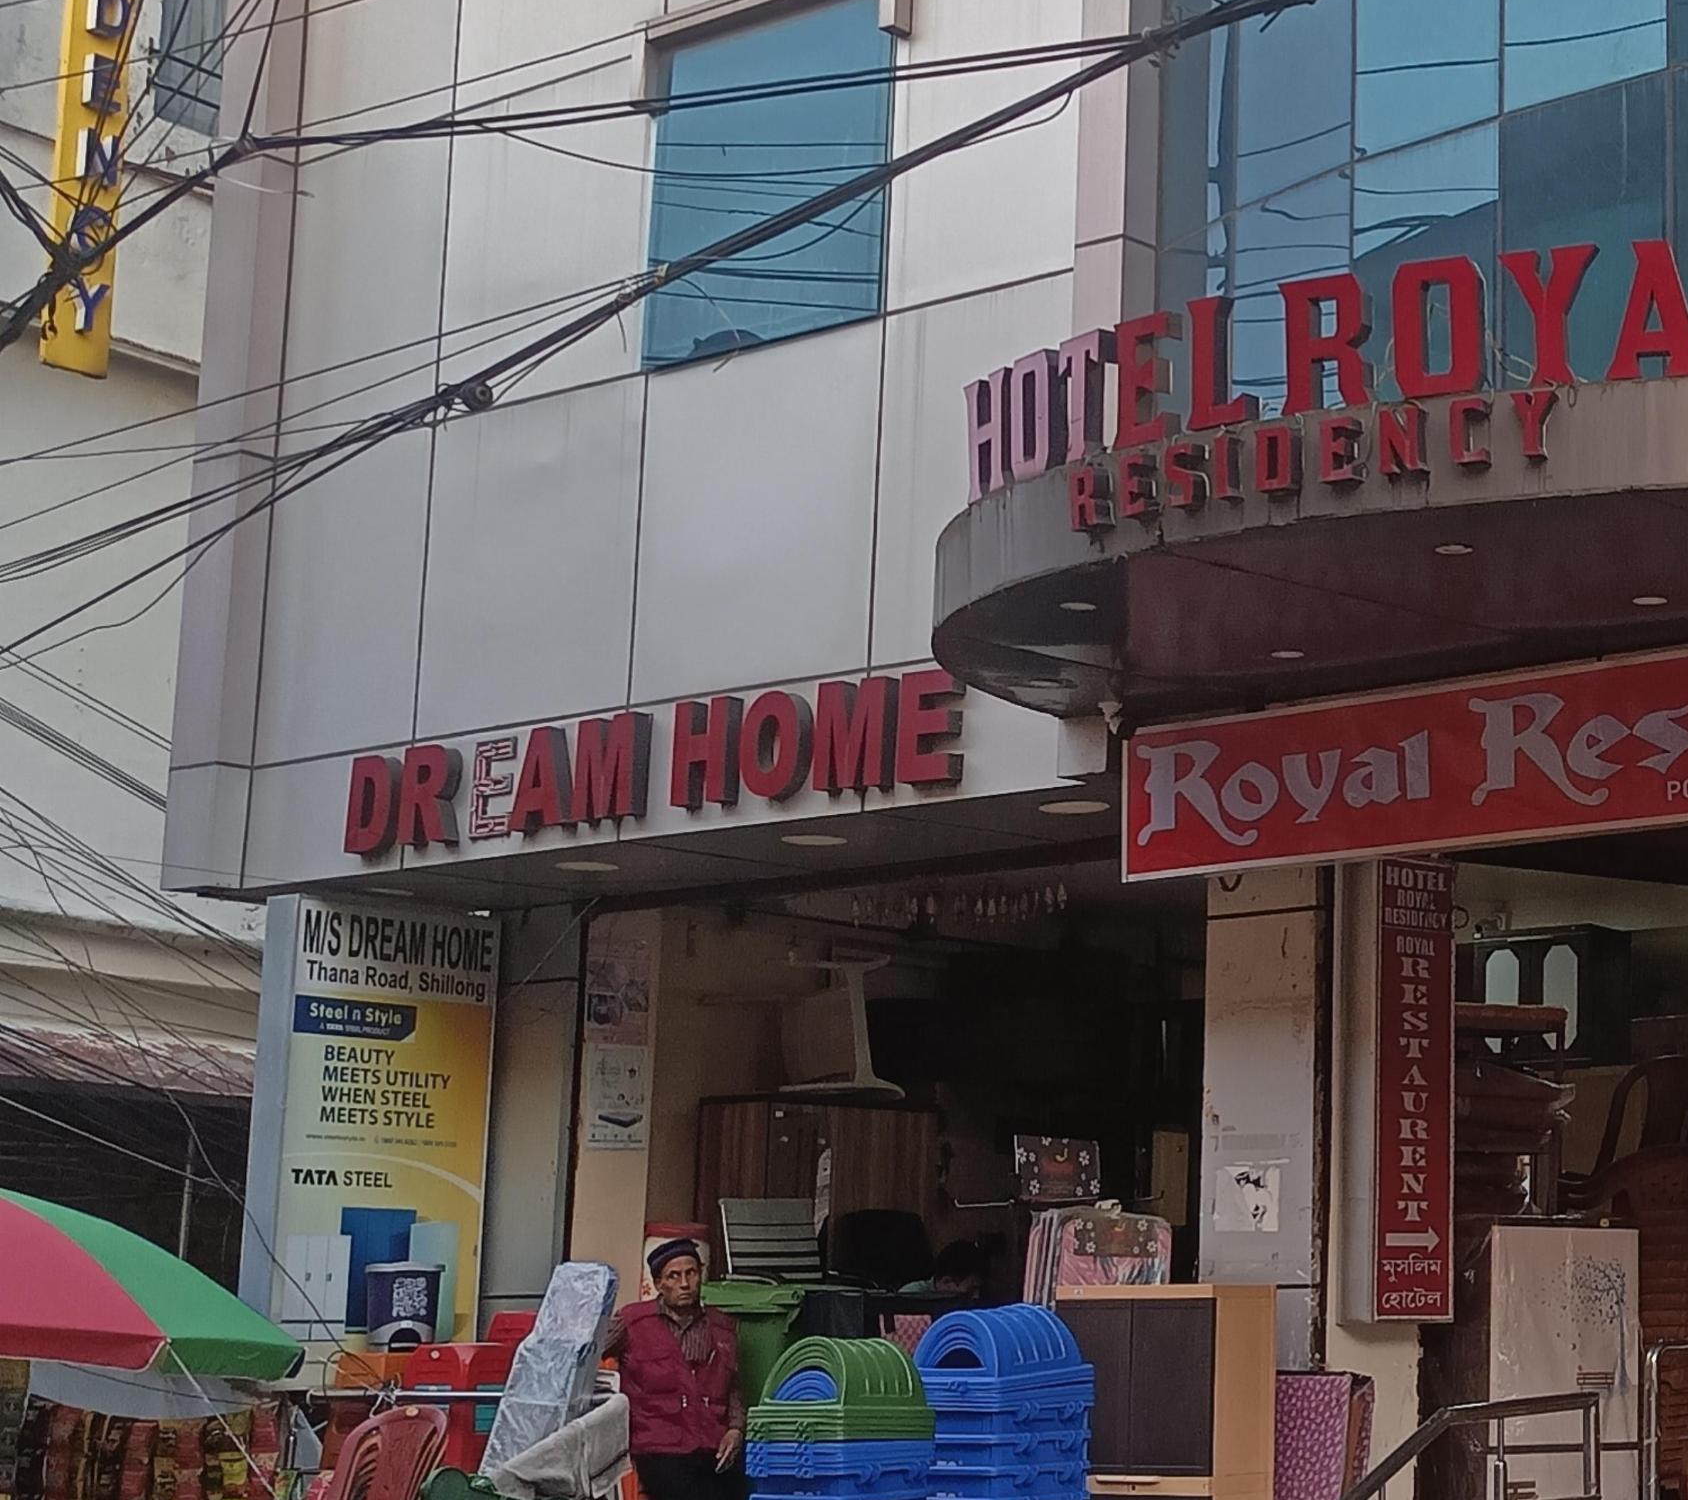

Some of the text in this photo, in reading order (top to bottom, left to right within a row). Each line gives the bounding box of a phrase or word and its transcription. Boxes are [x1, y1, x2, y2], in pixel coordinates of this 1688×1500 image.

[964, 294, 1260, 503] HOTEL
[1069, 390, 1559, 533] RESIDENCY
[344, 669, 966, 858] DREAM HOME
[1137, 730, 1431, 846] Royal
[1386, 866, 1447, 891] HOTEL
[1397, 888, 1436, 910] ROYAL
[303, 909, 495, 973] M/S DREAM HOME
[1396, 935, 1435, 956] ROYAL
[307, 959, 486, 1002] Thana Road, Shillong
[309, 1002, 349, 1020] Steel
[365, 1007, 402, 1026] Style
[324, 1045, 395, 1066] BEAUTY
[323, 1065, 451, 1090] MEETS UTILITY
[1397, 956, 1431, 1221] RESTAURENT
[322, 1086, 431, 1109] WHEN STEEL
[320, 1106, 435, 1129] MEETS STYLE
[291, 1168, 393, 1188] TATA STEEL
[1382, 1253, 1442, 1283] মুসলিম
[1382, 1286, 1442, 1309] হোটেল
